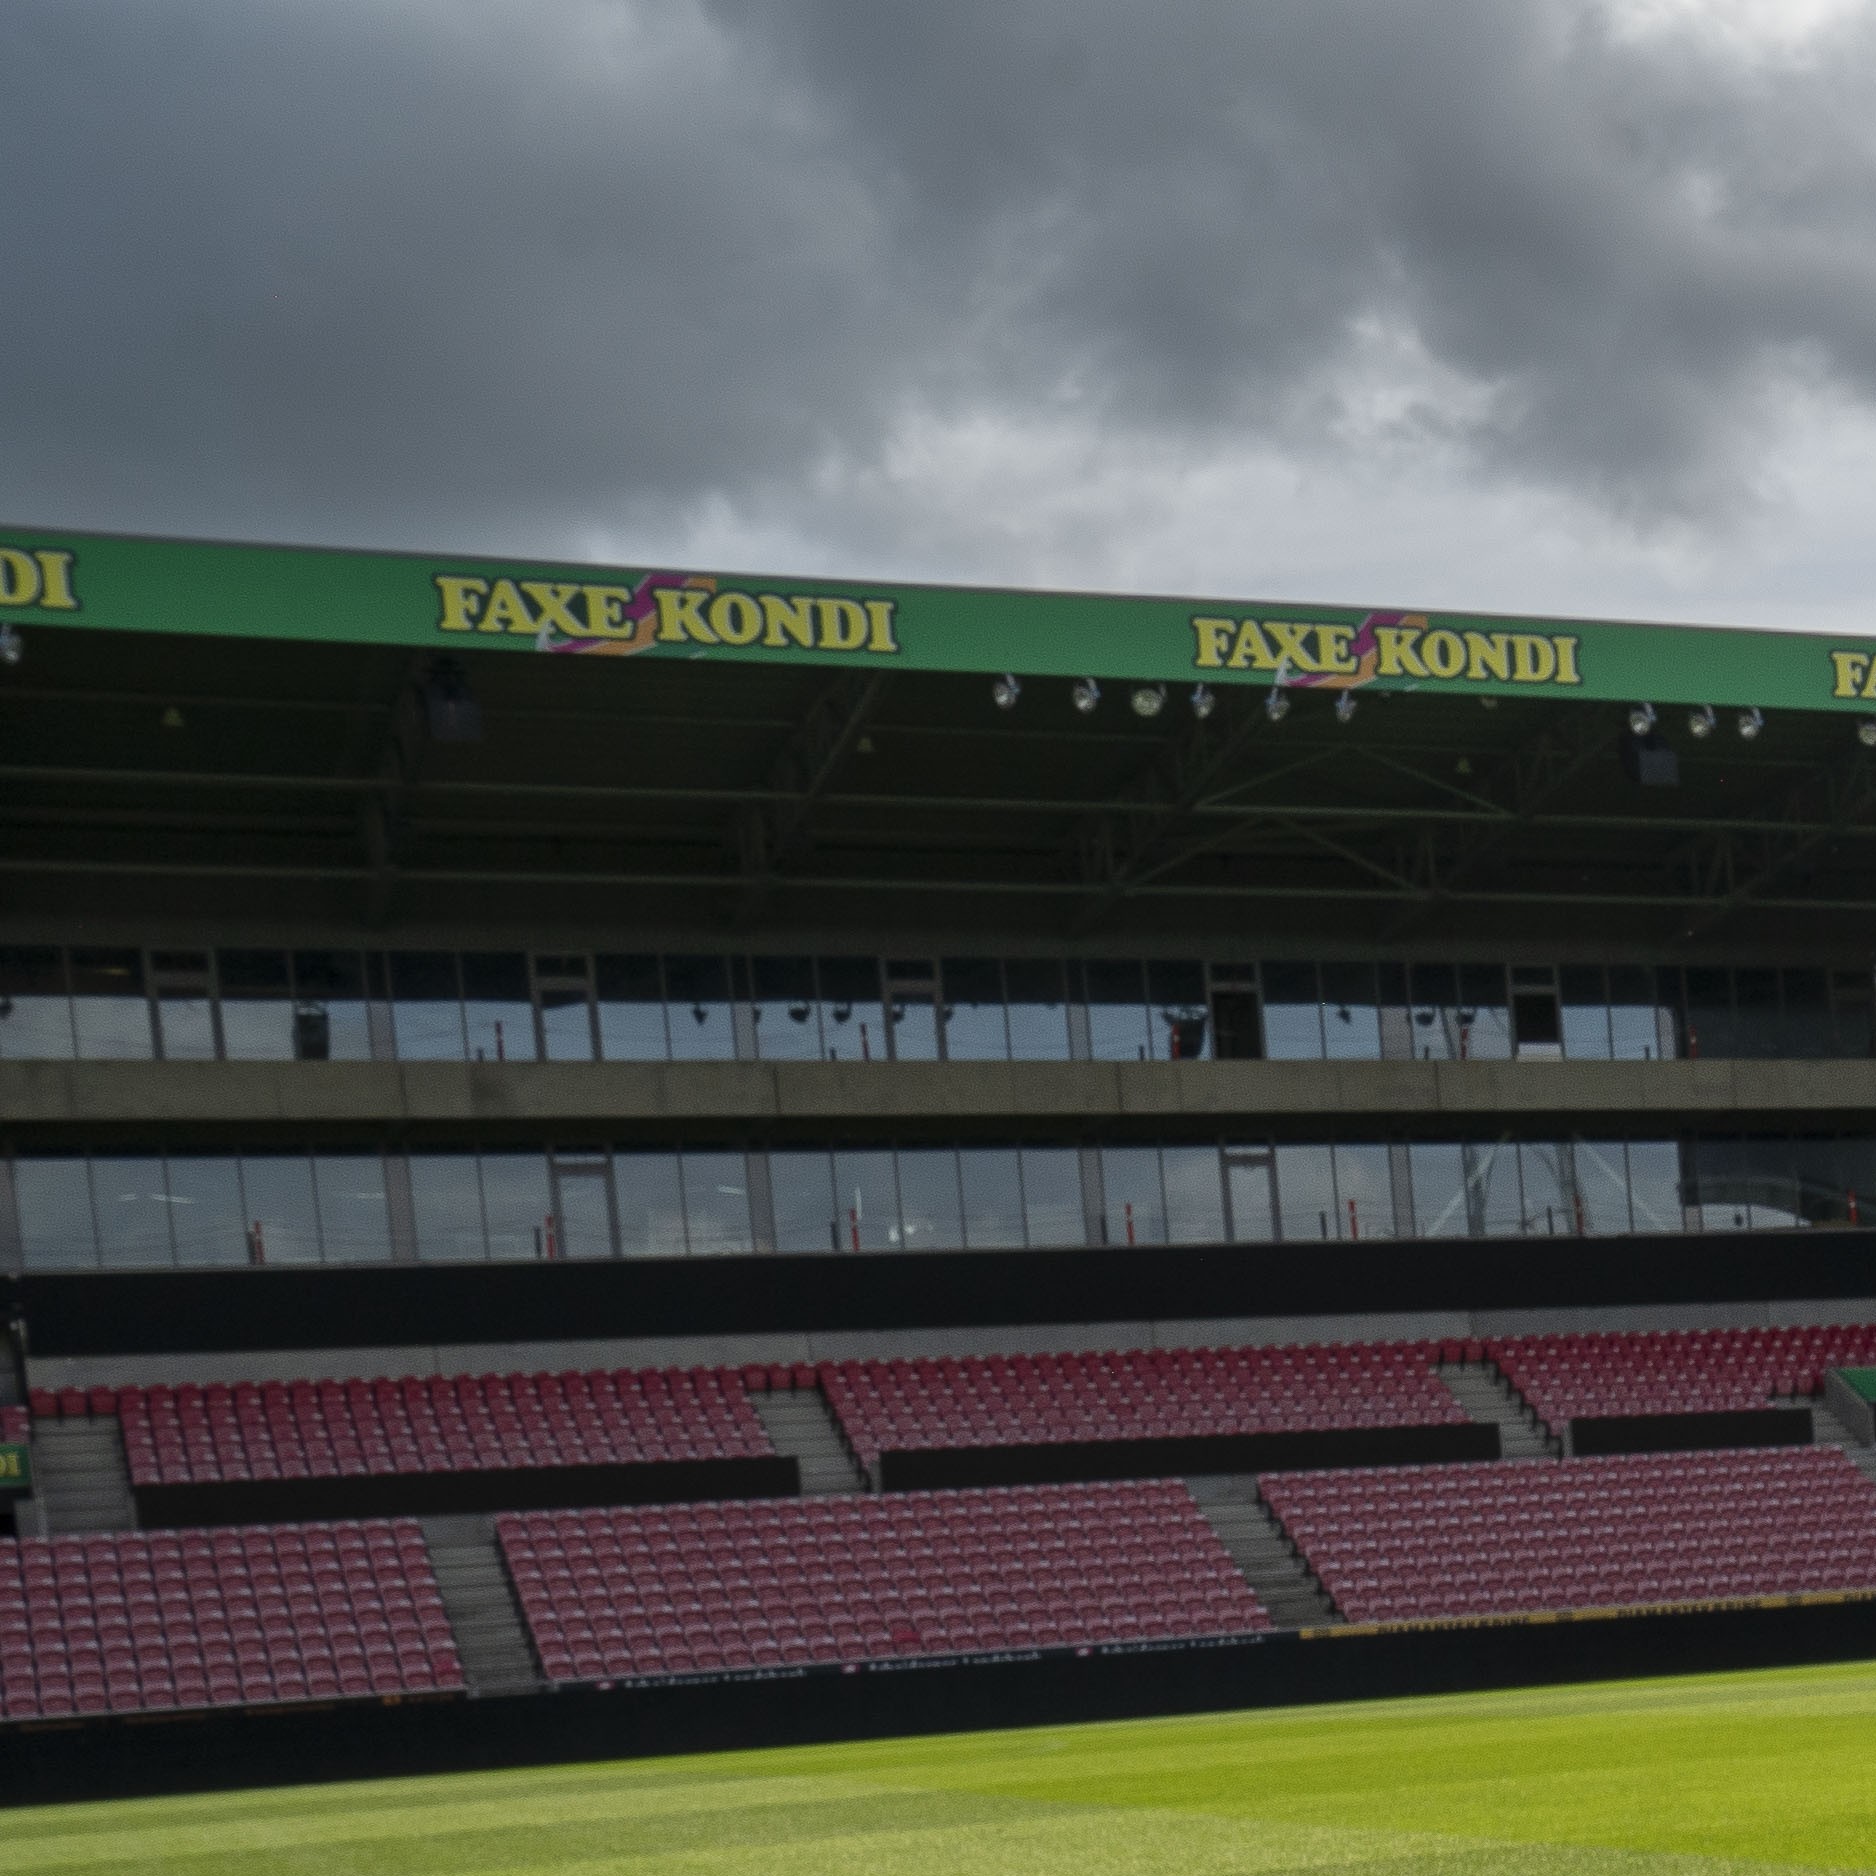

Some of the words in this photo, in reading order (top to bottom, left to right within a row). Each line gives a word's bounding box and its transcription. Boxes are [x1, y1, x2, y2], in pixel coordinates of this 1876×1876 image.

[434, 575, 636, 640] FAXE
[653, 587, 899, 653] KONDI
[1192, 616, 1357, 674] FAXE
[1373, 626, 1582, 685] KONDI
